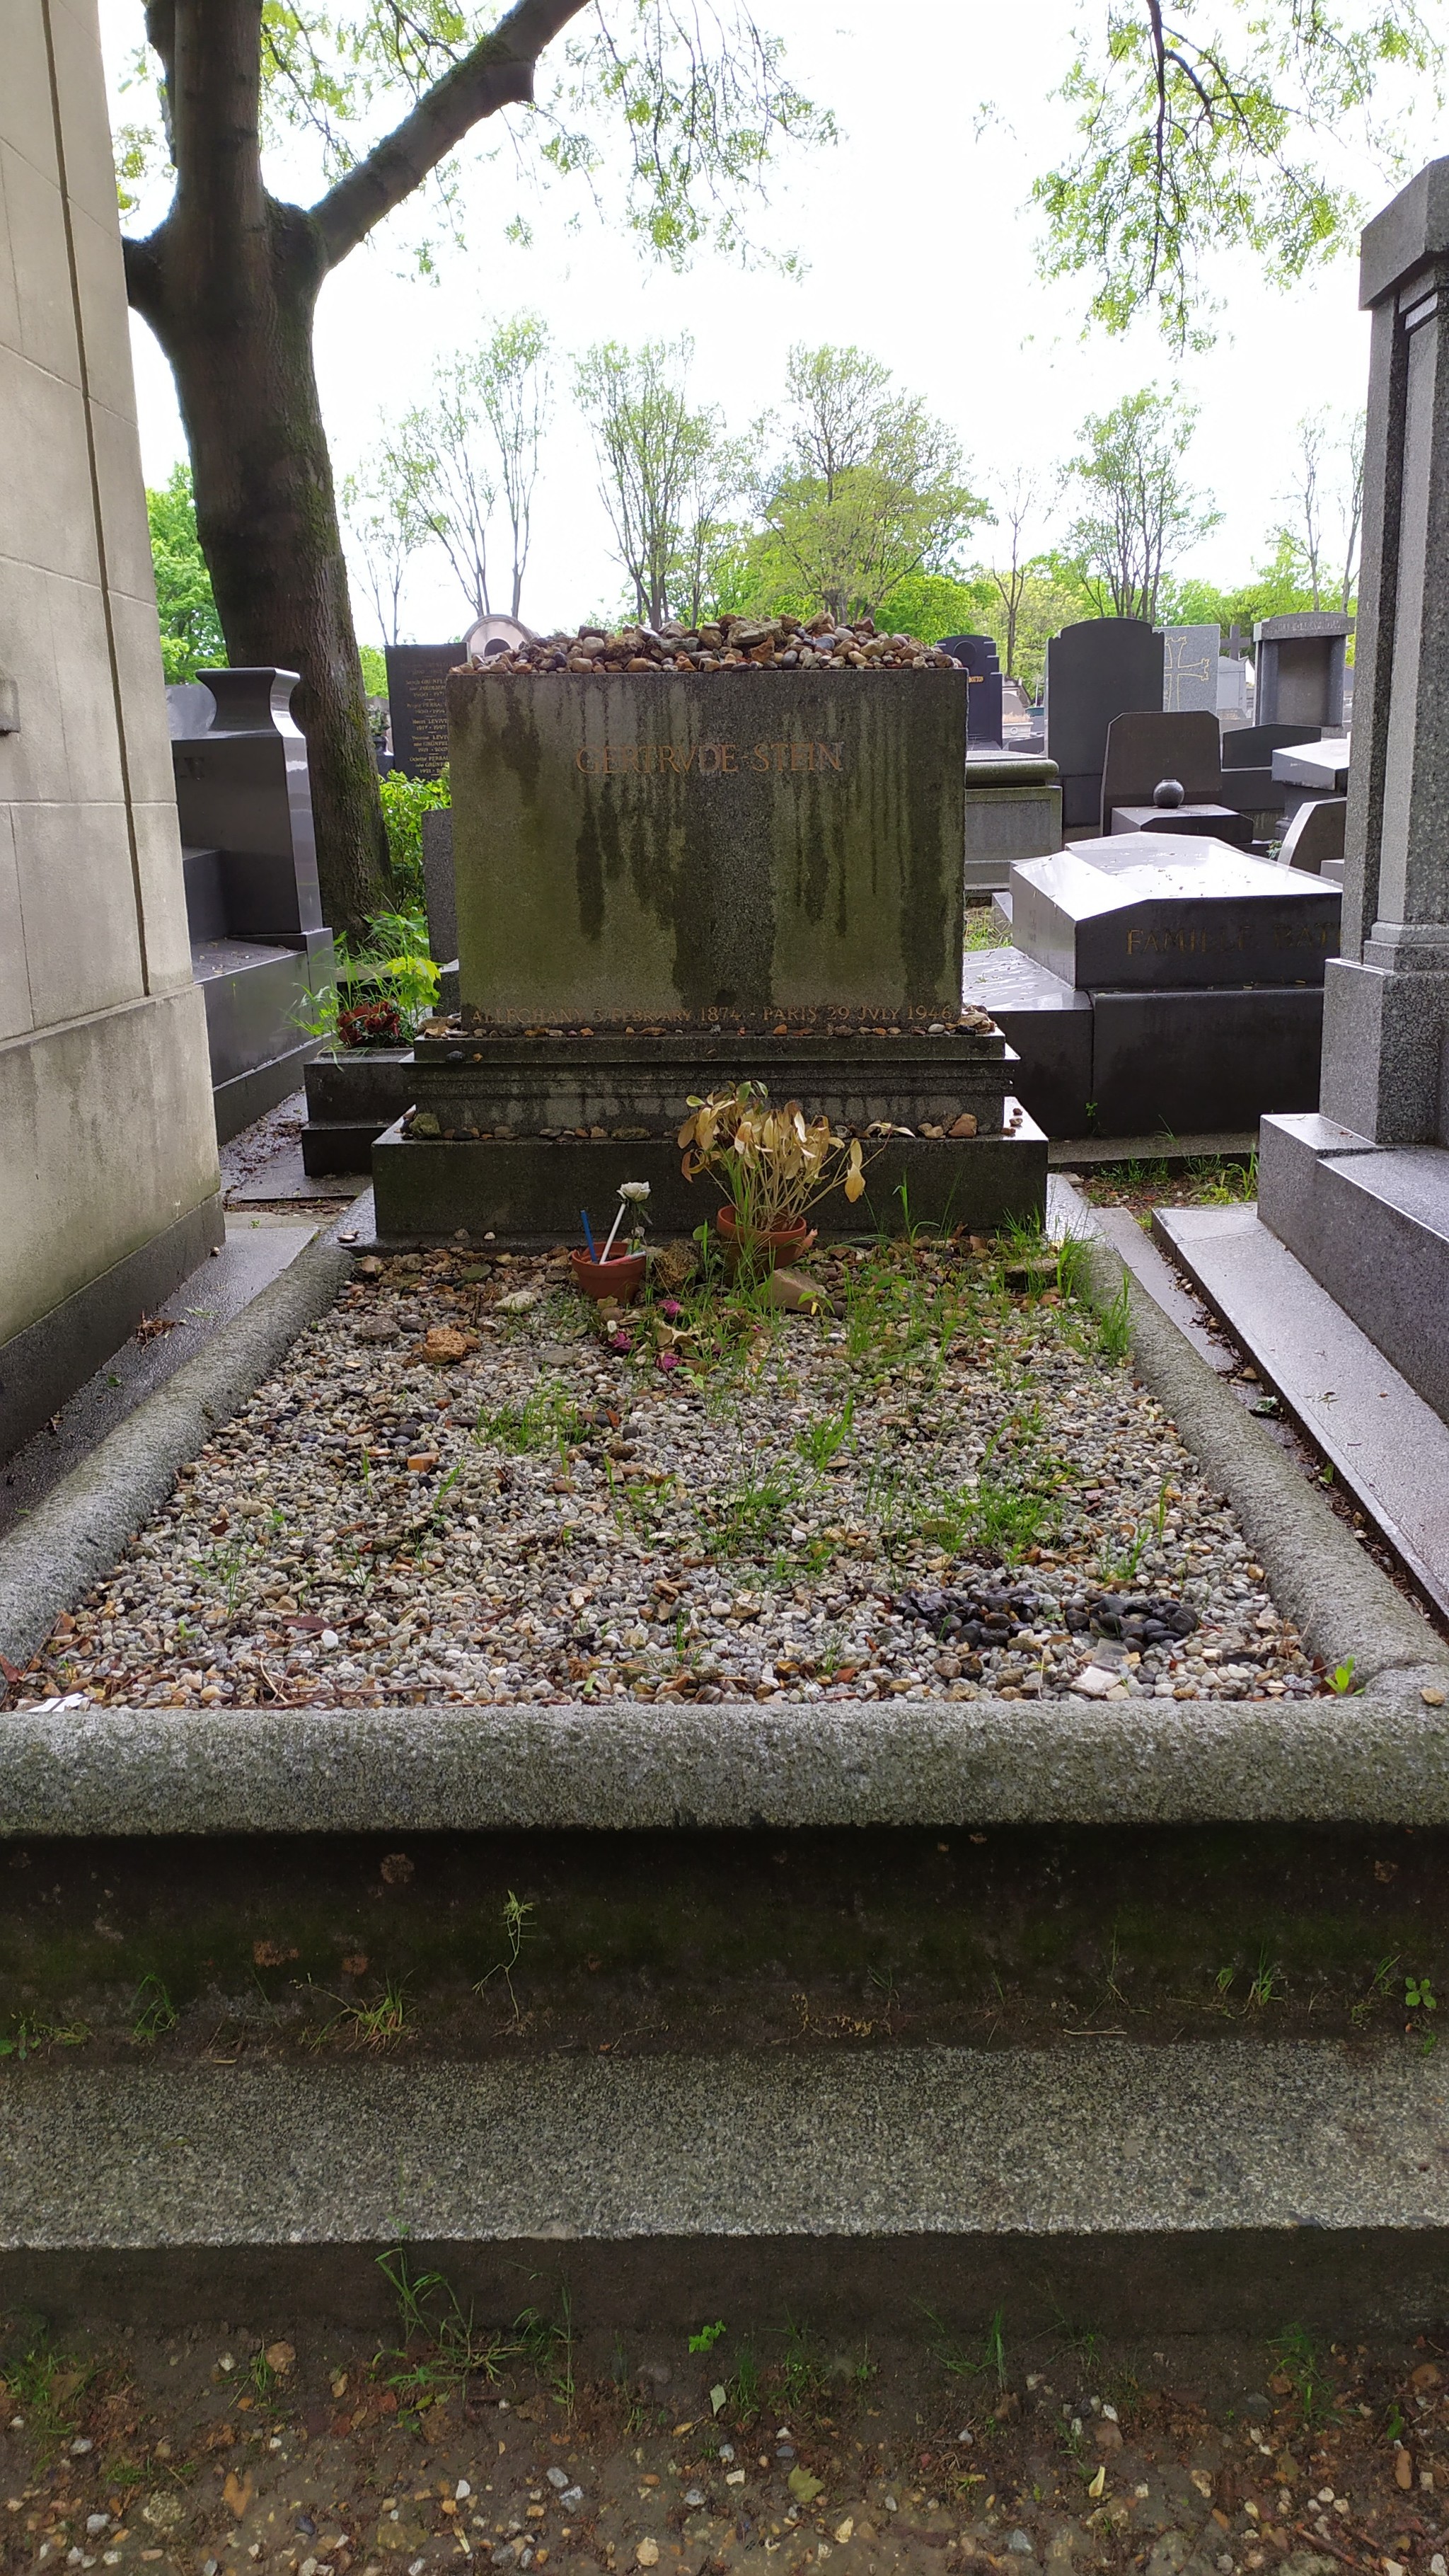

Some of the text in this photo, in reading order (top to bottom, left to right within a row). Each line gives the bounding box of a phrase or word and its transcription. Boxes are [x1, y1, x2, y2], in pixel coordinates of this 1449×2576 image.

[700, 1006, 742, 1022] 1874
[763, 1005, 818, 1023] PARIS
[826, 1005, 850, 1021] 29
[907, 1004, 953, 1020] 1946
